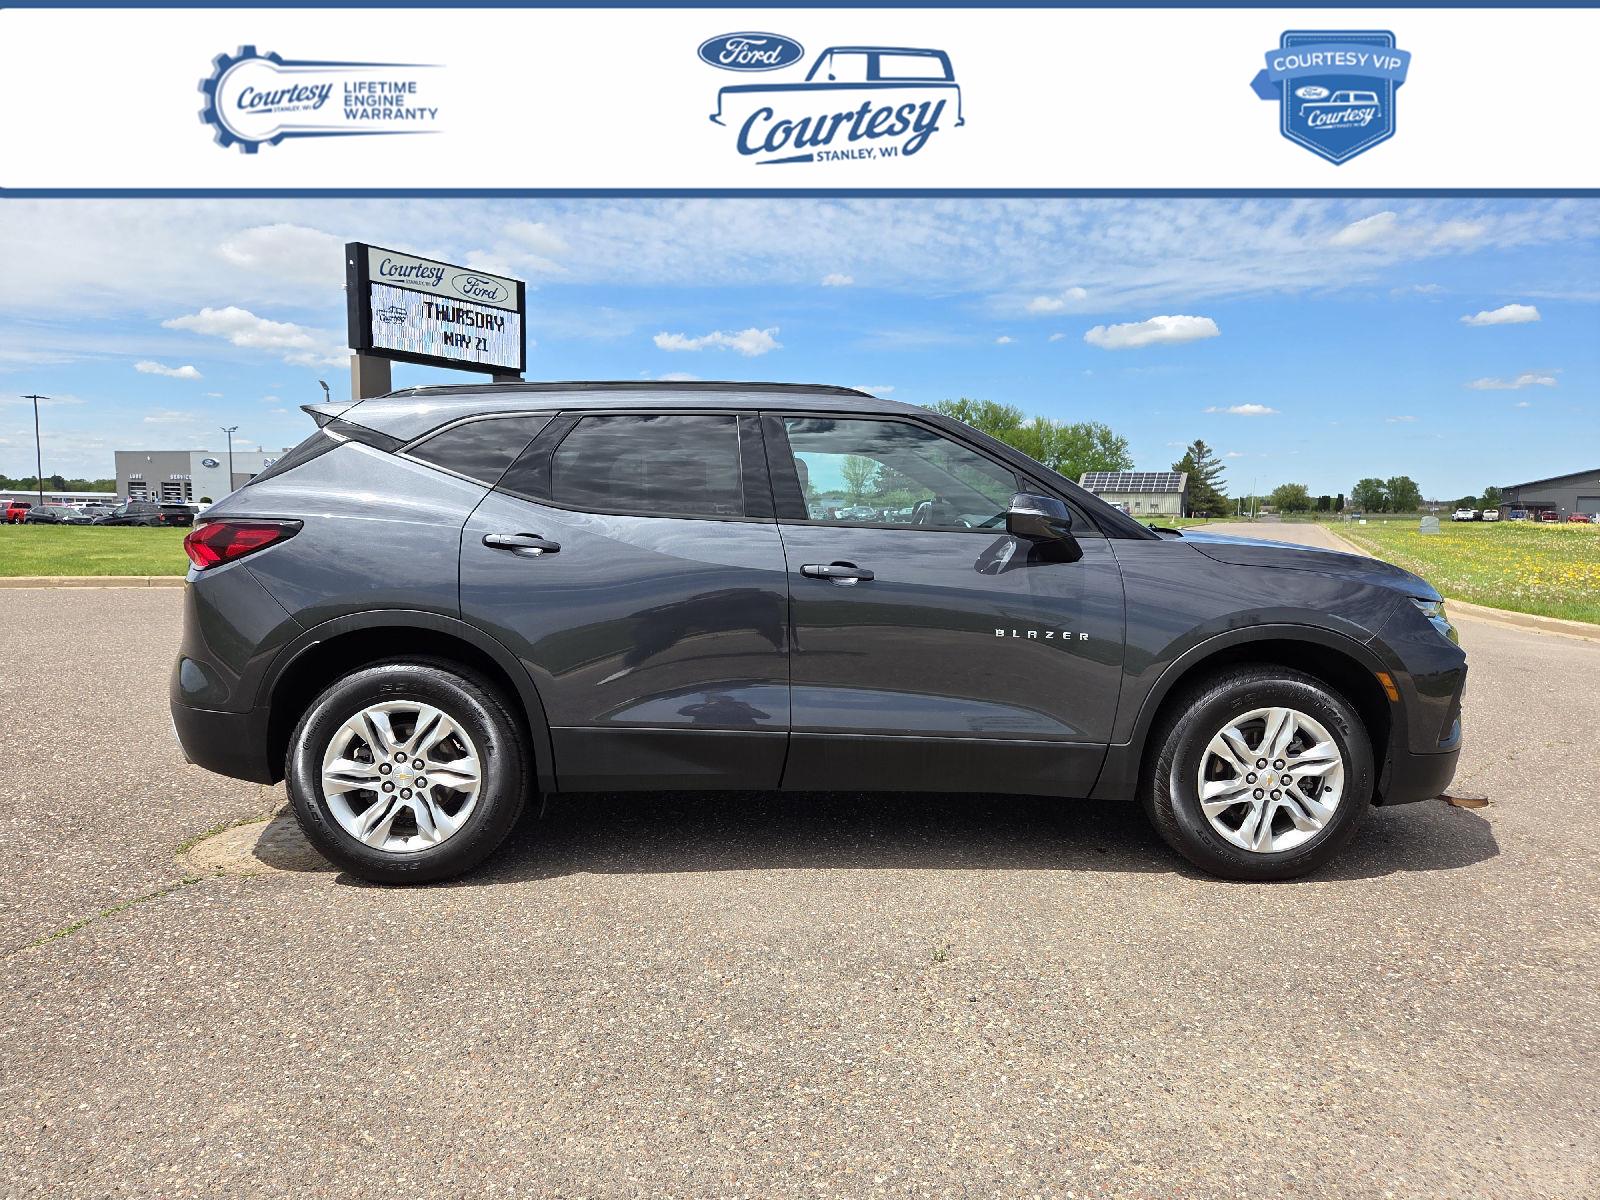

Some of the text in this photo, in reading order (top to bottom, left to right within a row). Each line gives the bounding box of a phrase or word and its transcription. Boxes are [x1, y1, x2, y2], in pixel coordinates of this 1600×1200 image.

[379, 258, 499, 300] Courtesy Ford
[423, 301, 505, 333] THURSDAY
[443, 331, 488, 352] MAY 21
[995, 629, 1089, 640] BLAZER
